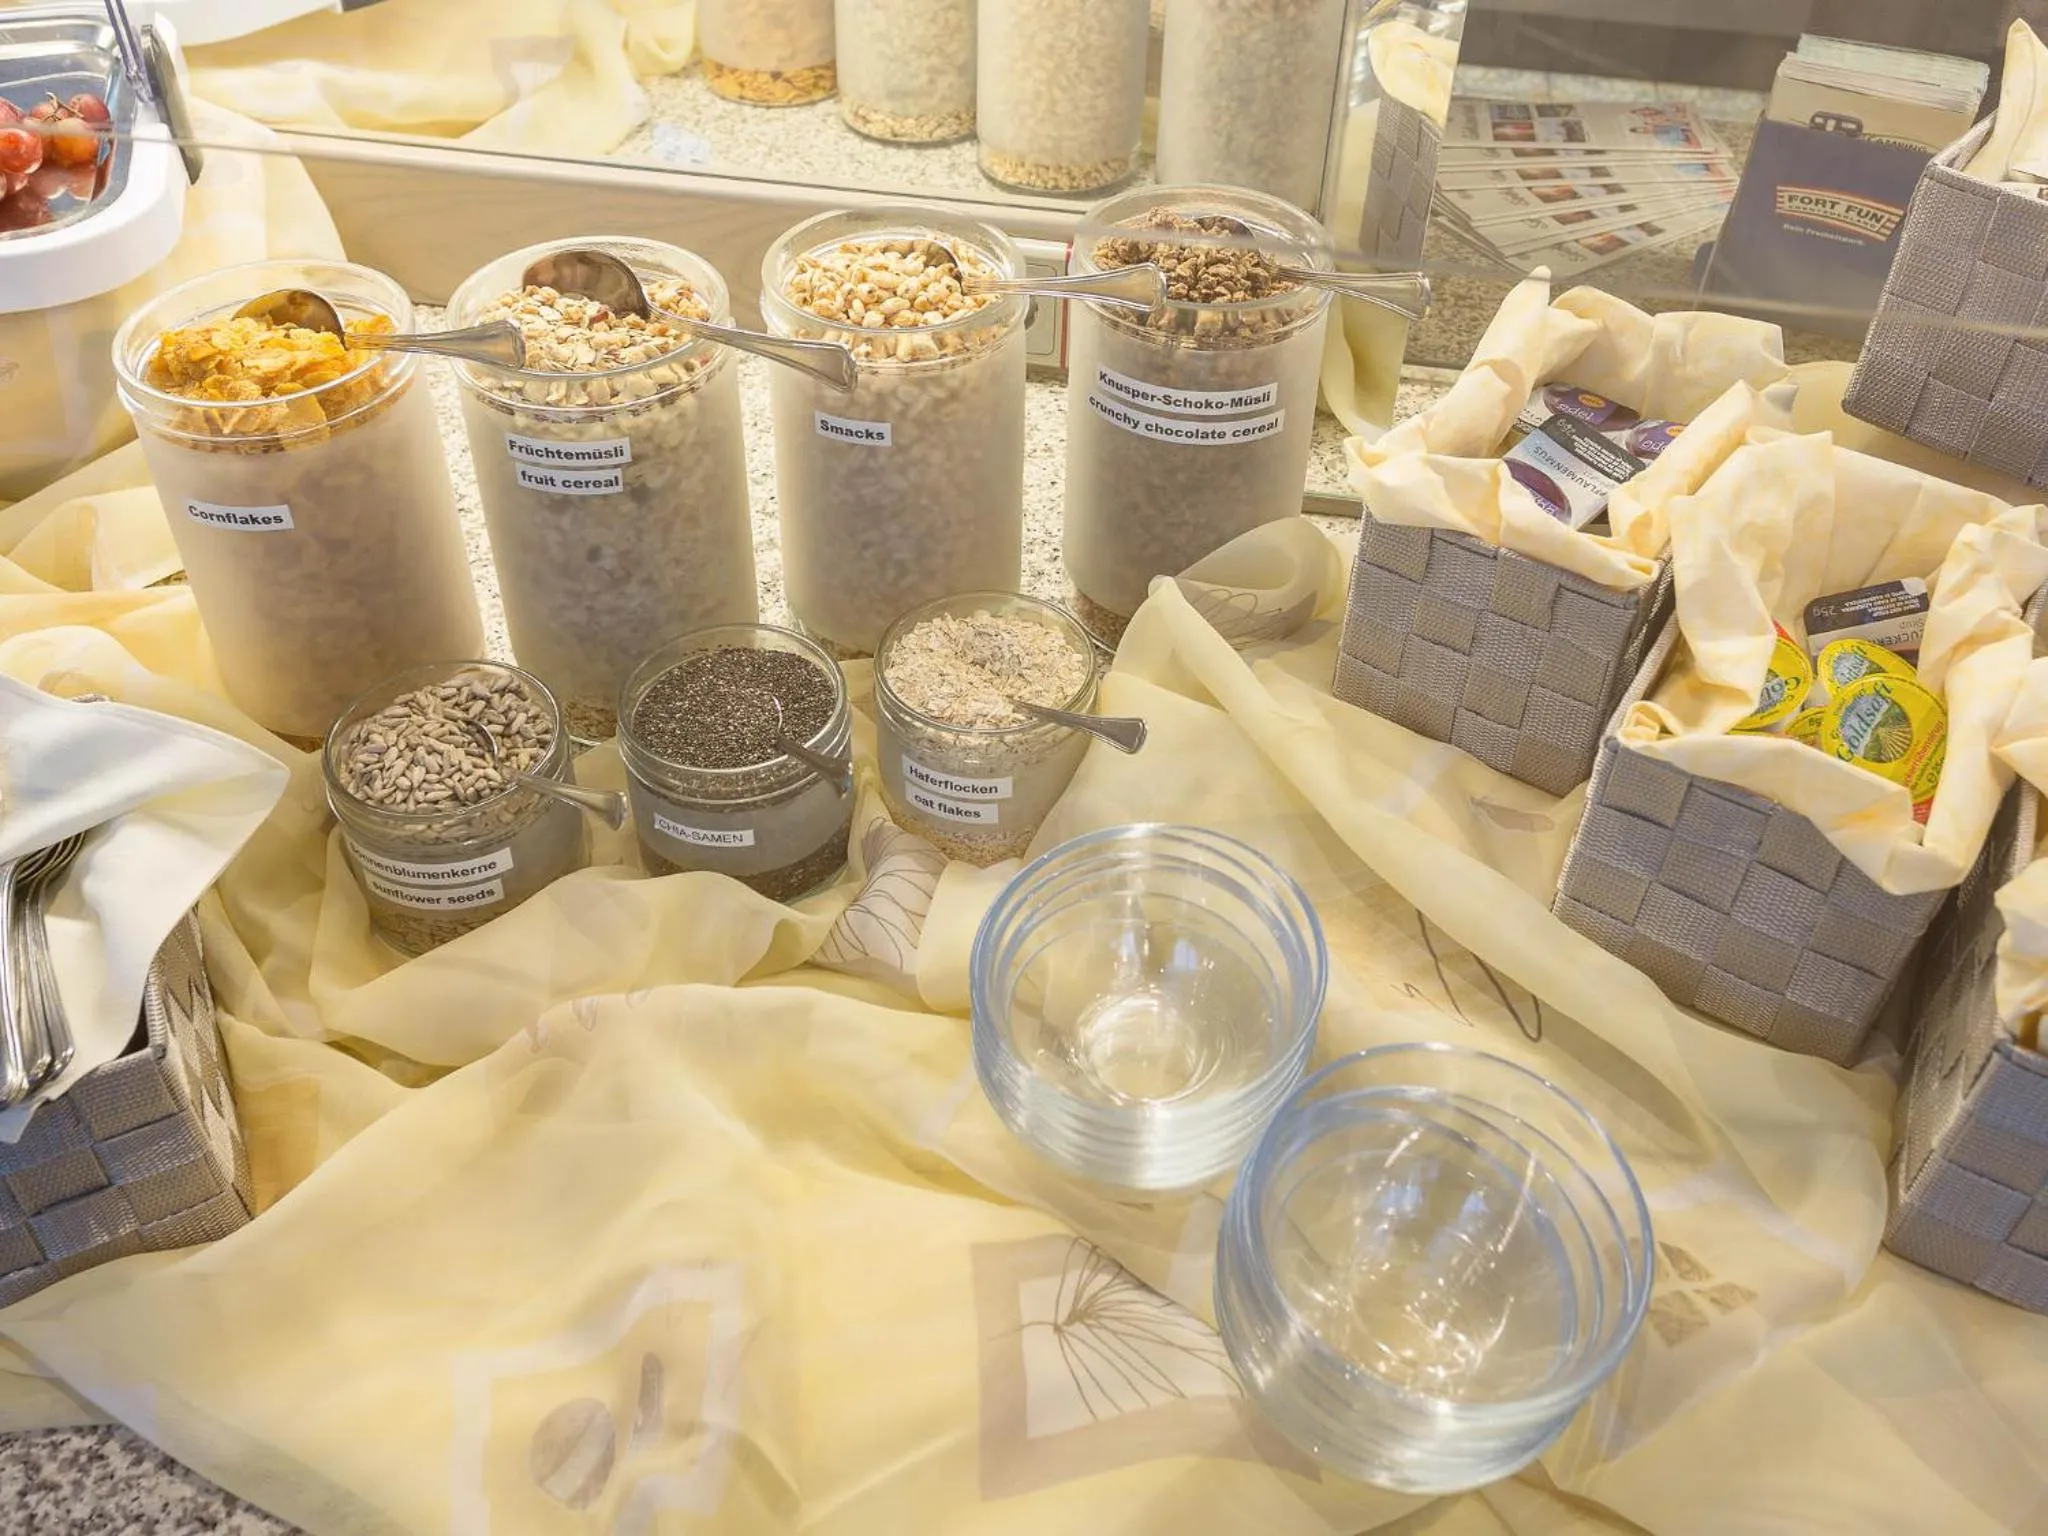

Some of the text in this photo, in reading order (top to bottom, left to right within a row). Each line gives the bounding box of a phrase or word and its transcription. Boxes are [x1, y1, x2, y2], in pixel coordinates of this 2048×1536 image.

[1787, 194, 1884, 225] FORT FUN
[1099, 370, 1271, 409] Knusper-Schoko-Müsli
[820, 419, 885, 440] Smacks
[1089, 395, 1279, 440] crunchy chocolate cereal
[508, 440, 625, 461] Früchtemüsli
[520, 470, 620, 490] fruit cereal
[188, 505, 284, 527] Cornflakes
[1836, 680, 1893, 762] Goldsaft
[909, 765, 998, 795] Haferflocken
[914, 793, 981, 820] oat flakes
[659, 818, 743, 844] CHIA-SAMEN
[447, 887, 496, 905] seeds
